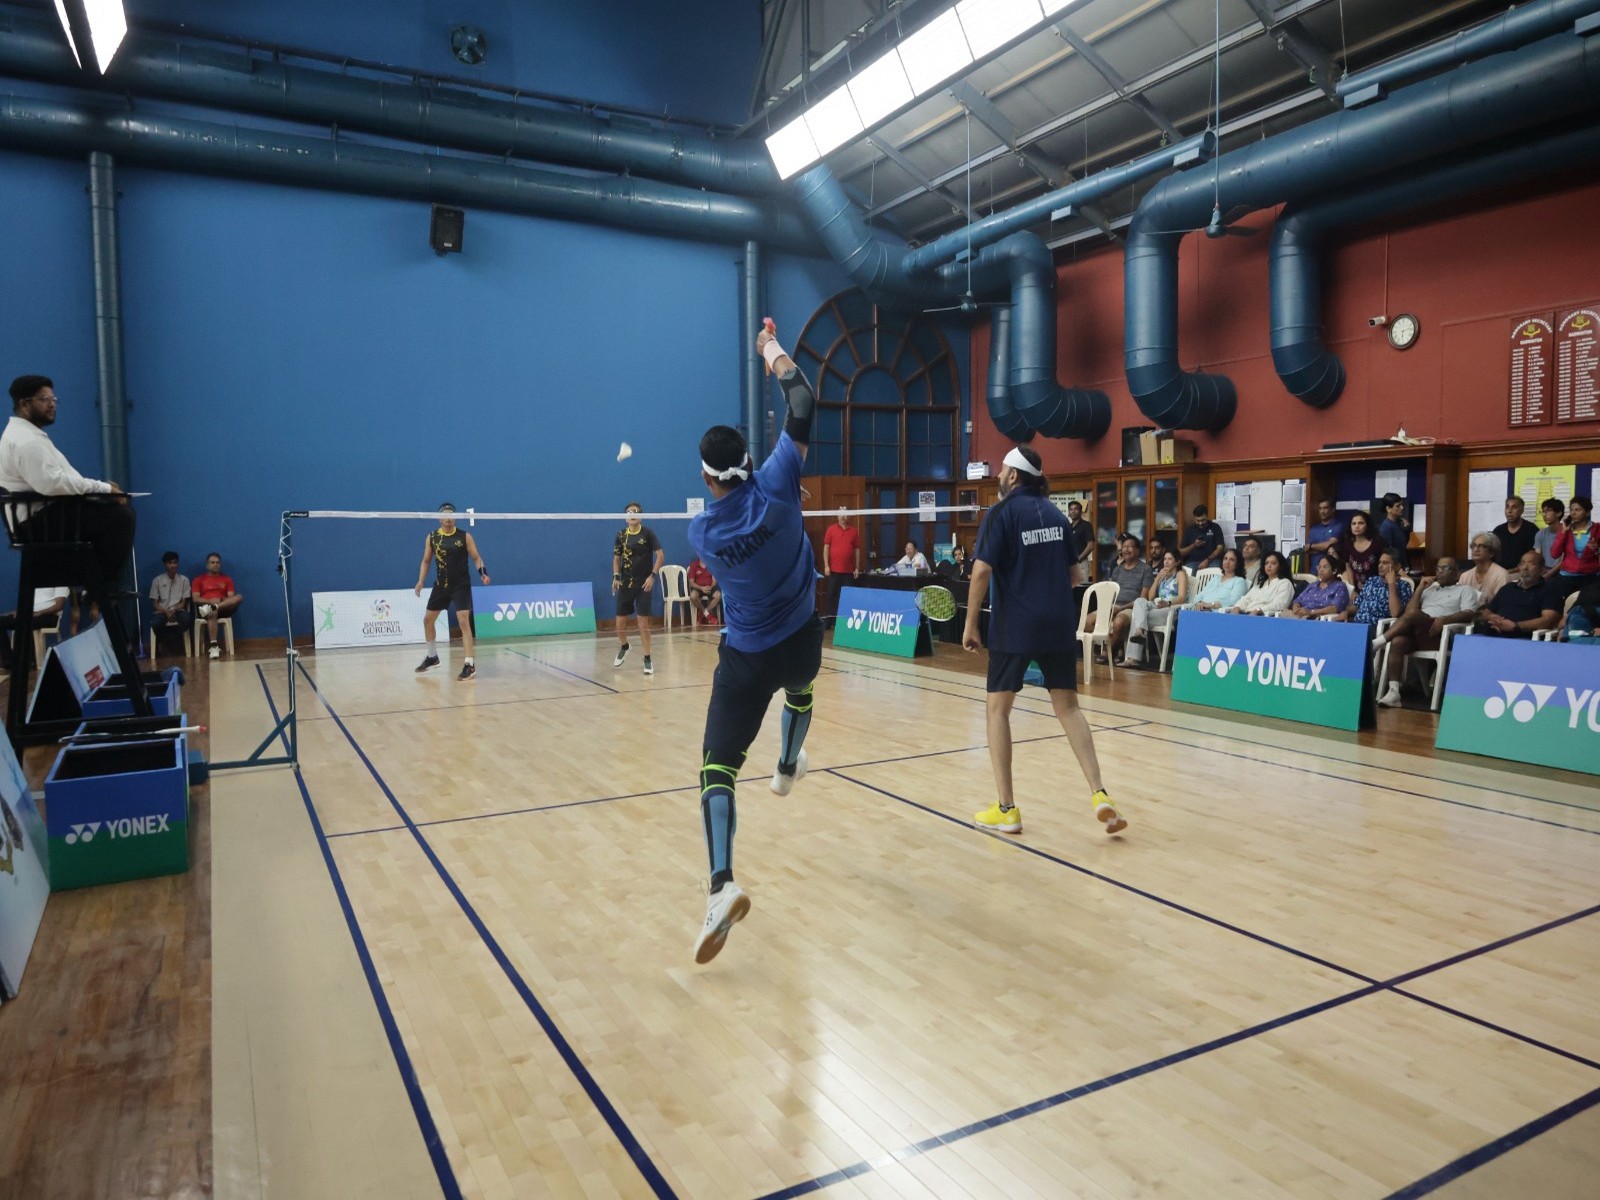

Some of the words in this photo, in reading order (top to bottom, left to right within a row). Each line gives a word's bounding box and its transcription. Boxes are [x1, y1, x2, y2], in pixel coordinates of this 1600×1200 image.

[715, 524, 775, 569] THAKUR
[525, 600, 575, 619] YONEX
[362, 626, 403, 635] GURUKUL
[868, 611, 903, 635] YONEX
[1245, 649, 1326, 692] YONEX
[106, 813, 170, 839] YONEX
